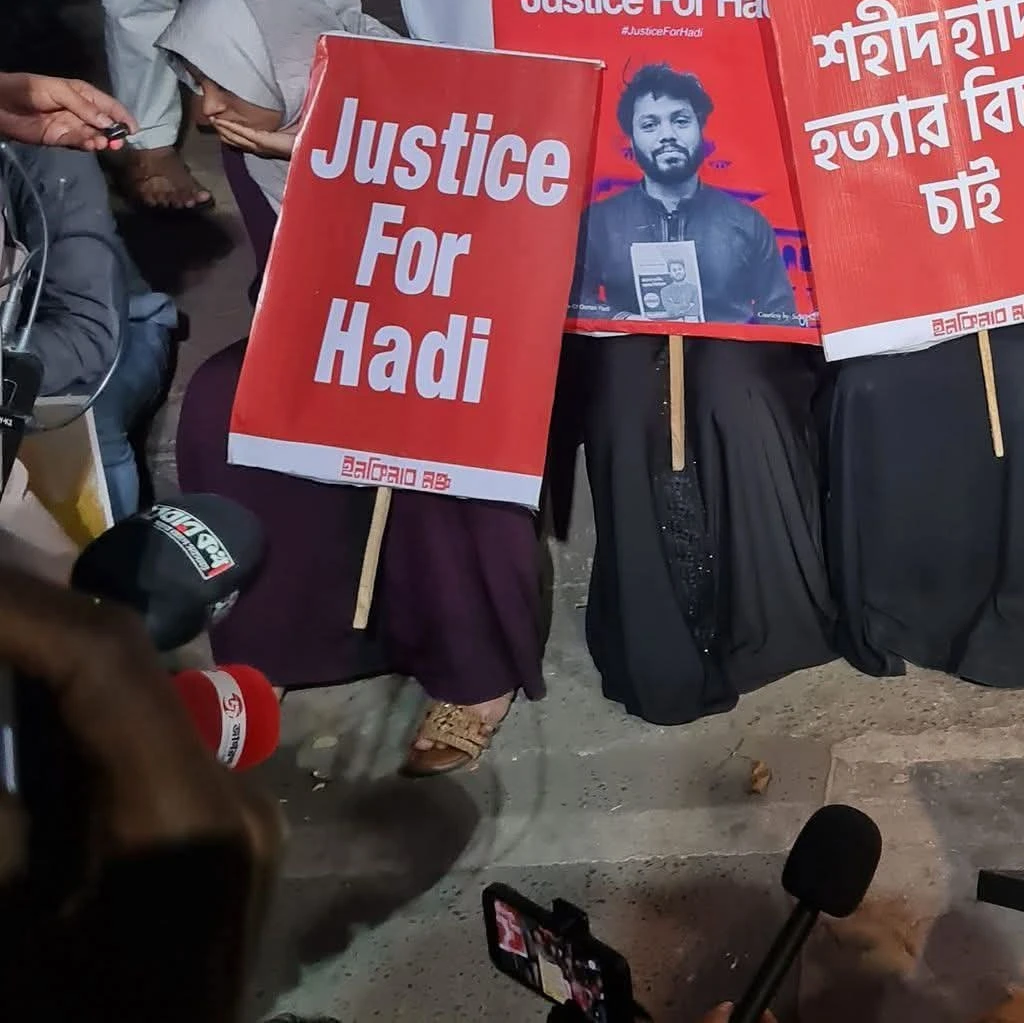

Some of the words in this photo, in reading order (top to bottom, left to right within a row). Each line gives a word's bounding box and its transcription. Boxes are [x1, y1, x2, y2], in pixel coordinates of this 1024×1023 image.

[621, 26, 703, 38] #JusticeForHadi
[310, 97, 570, 206] Justice
[804, 94, 950, 171] হত্যার
[919, 156, 1004, 235] চাই
[355, 202, 472, 297] For
[314, 298, 492, 404] Hadi
